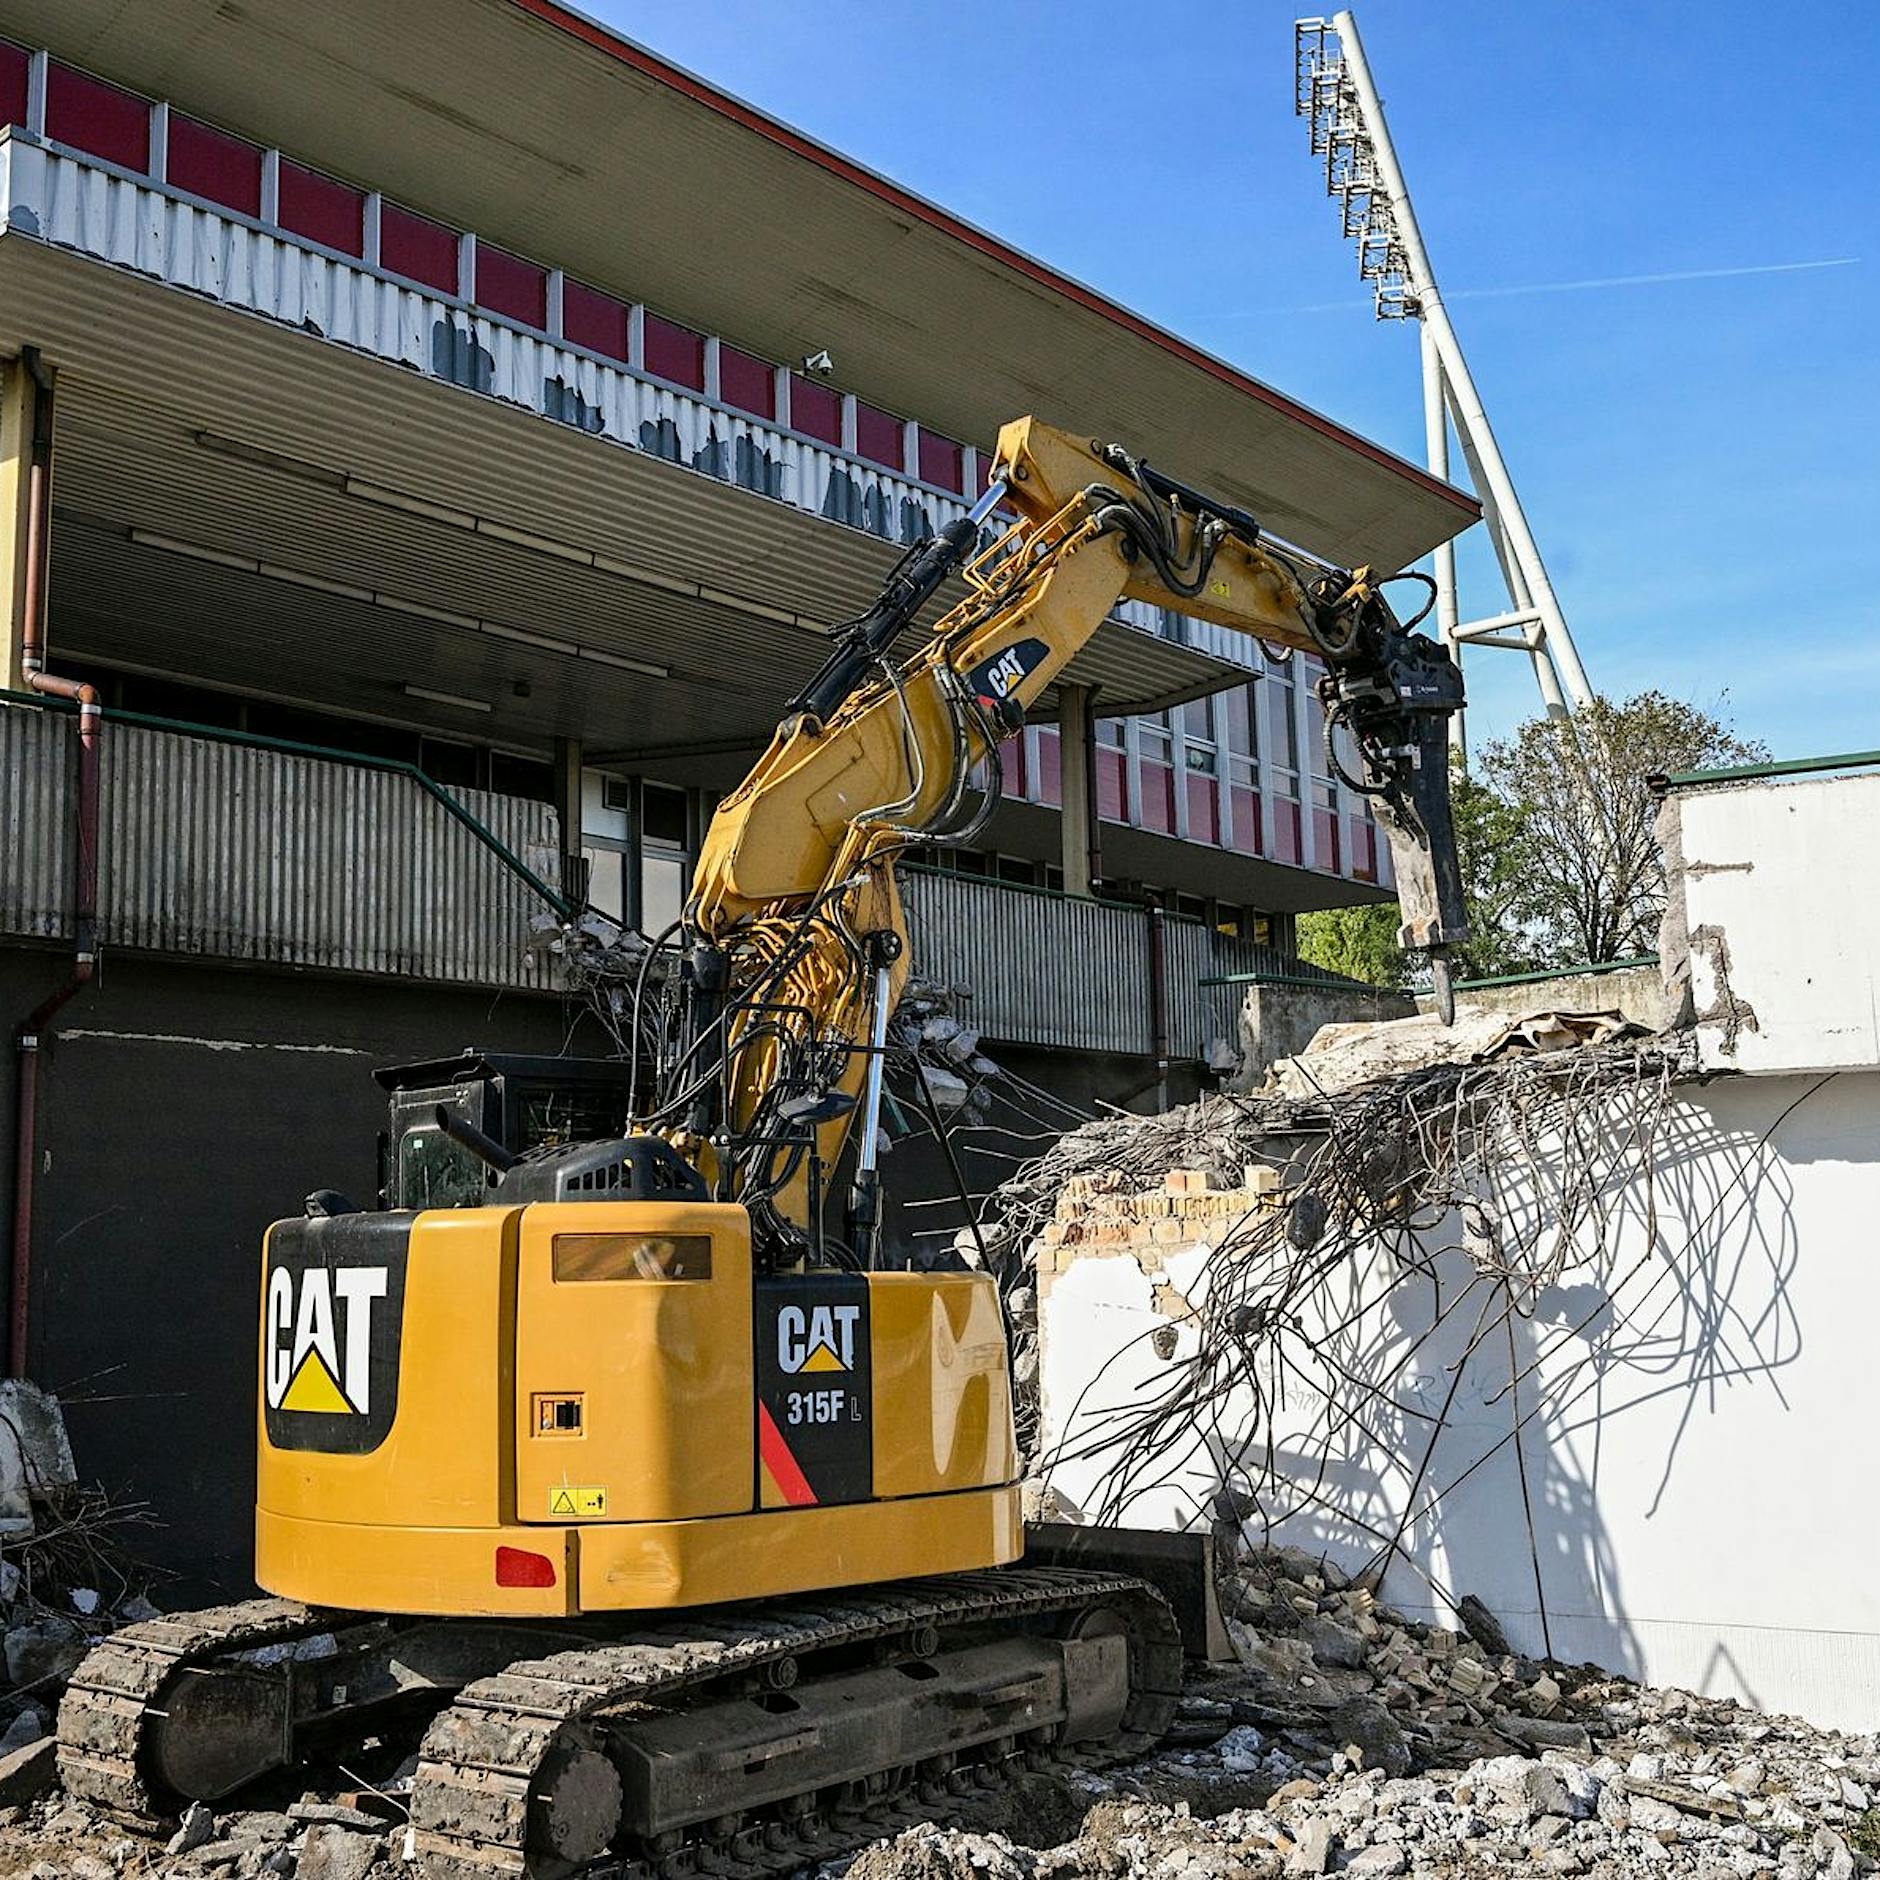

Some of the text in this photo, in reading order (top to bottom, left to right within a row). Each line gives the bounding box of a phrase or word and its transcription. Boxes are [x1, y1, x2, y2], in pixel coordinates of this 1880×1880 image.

[988, 647, 1026, 698] CAT
[267, 1266, 389, 1416] CAT
[778, 1305, 860, 1374] CAT
[787, 1389, 862, 1425] 315F L
